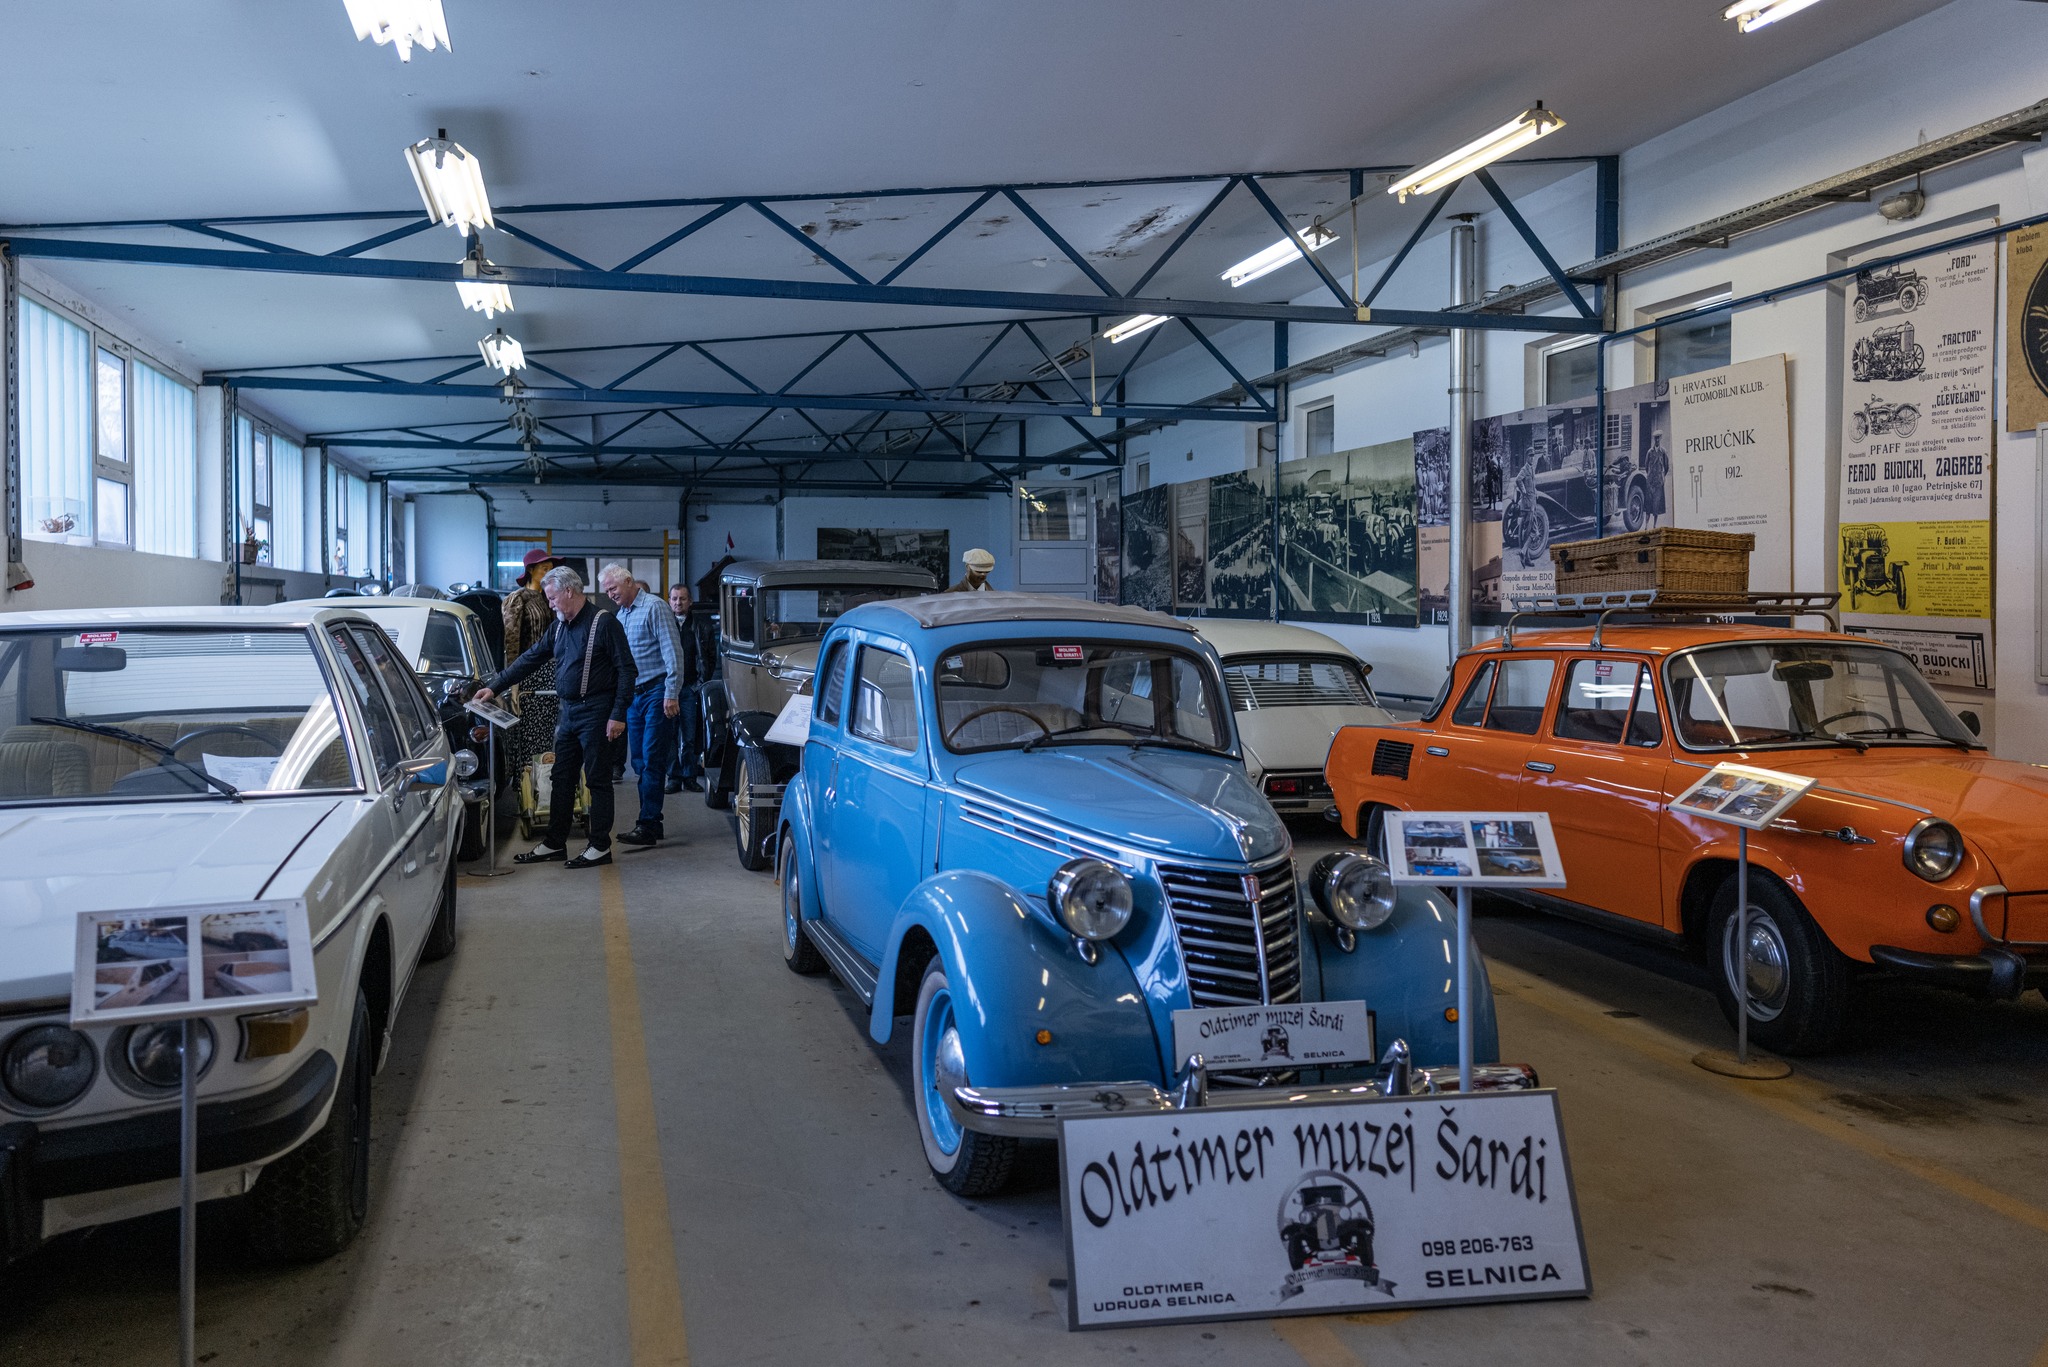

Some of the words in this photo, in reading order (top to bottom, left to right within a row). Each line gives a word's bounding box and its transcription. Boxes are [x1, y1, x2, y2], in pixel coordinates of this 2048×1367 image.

[2016, 231, 2040, 244] Amblem
[2016, 245, 2032, 256] kluba
[1941, 369, 1958, 378] revije
[1682, 375, 1726, 393] HRVATSKI
[1684, 386, 1738, 406] AUTOMOBILNI
[1686, 429, 1756, 453] PRIRUČNIK
[1725, 466, 1743, 479] 1912.
[1848, 463, 1876, 482] FERDO
[1884, 459, 1926, 480] BUDICKI,
[1936, 455, 1982, 476] ZAGREB
[1926, 482, 1967, 492] Petrinjske
[1923, 654, 1970, 669] BUDICKI
[1200, 1012, 1260, 1039] Oldtimer
[1266, 1008, 1303, 1029] muzej
[1309, 1007, 1344, 1032] Šardi
[1080, 1125, 1274, 1228] Oldtimer
[1294, 1108, 1416, 1193] muzej
[1436, 1105, 1548, 1203] Šardi
[1422, 1241, 1456, 1257] 098
[1425, 1264, 1561, 1288] SELNICA
[1122, 1281, 1204, 1298] OLDTIMER
[1094, 1297, 1162, 1312] UDRUGA
[1167, 1292, 1236, 1307] SELNICA
